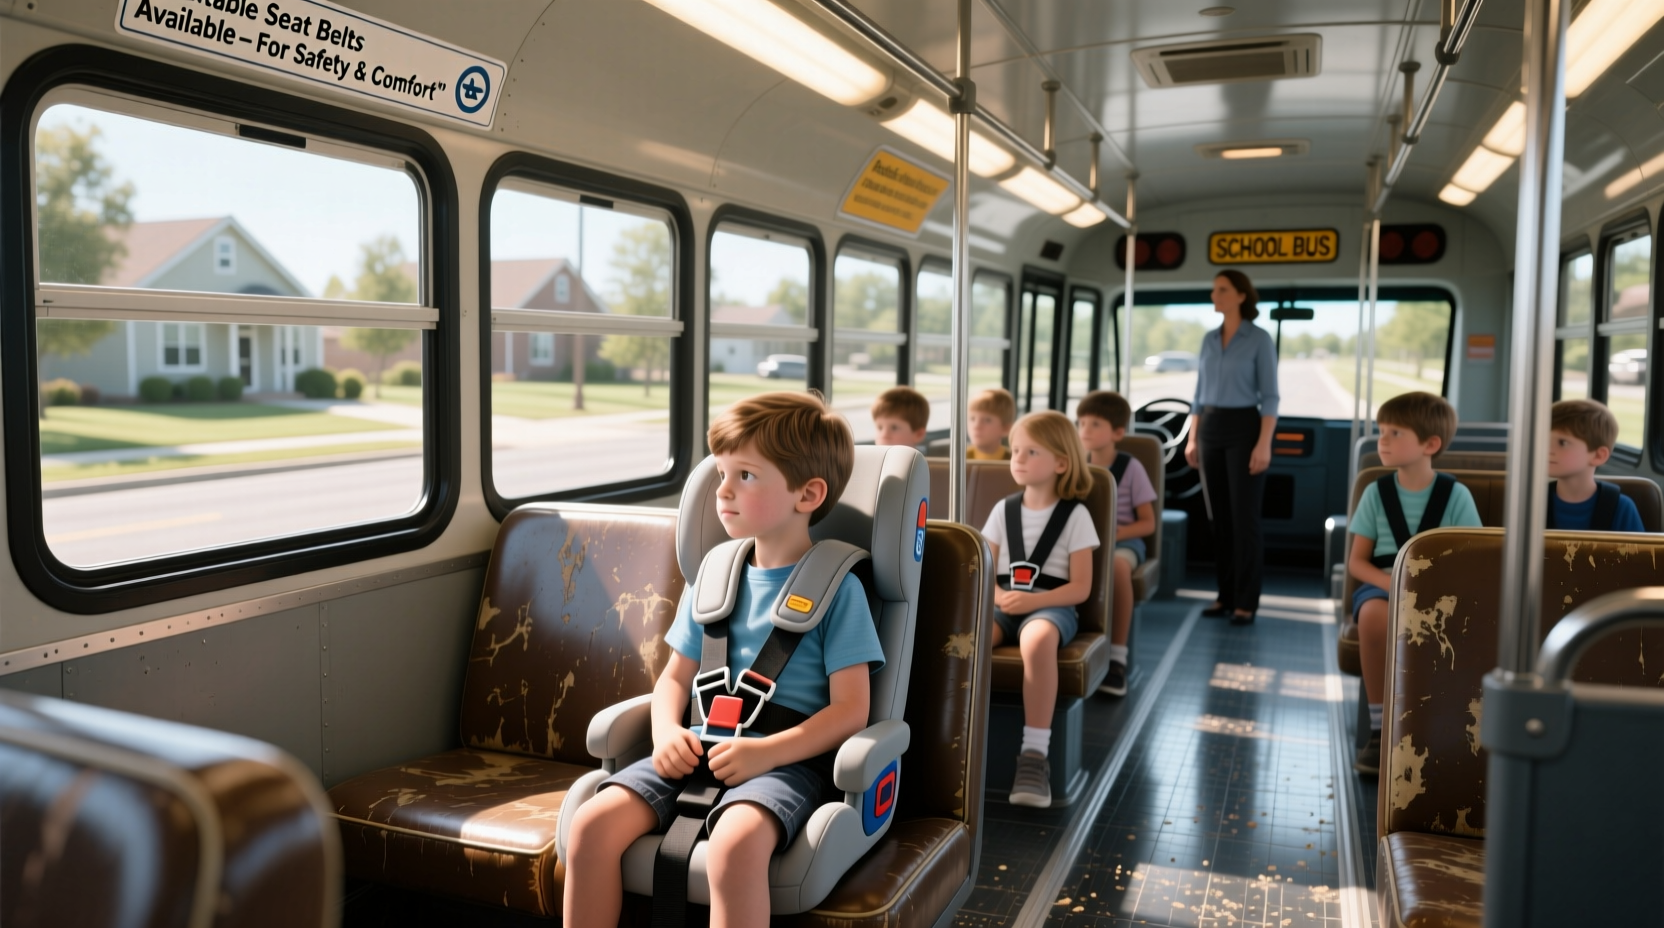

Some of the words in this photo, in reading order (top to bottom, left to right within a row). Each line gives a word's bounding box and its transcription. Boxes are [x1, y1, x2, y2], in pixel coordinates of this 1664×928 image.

[133, 0, 236, 45] Available
[256, 32, 291, 60] For
[293, 43, 351, 81] Safety
[354, 61, 367, 82] &
[264, 3, 312, 37] Seat
[316, 19, 365, 52] Belts
[1216, 236, 1288, 259] SCHOOL
[1293, 235, 1331, 257] BUS
